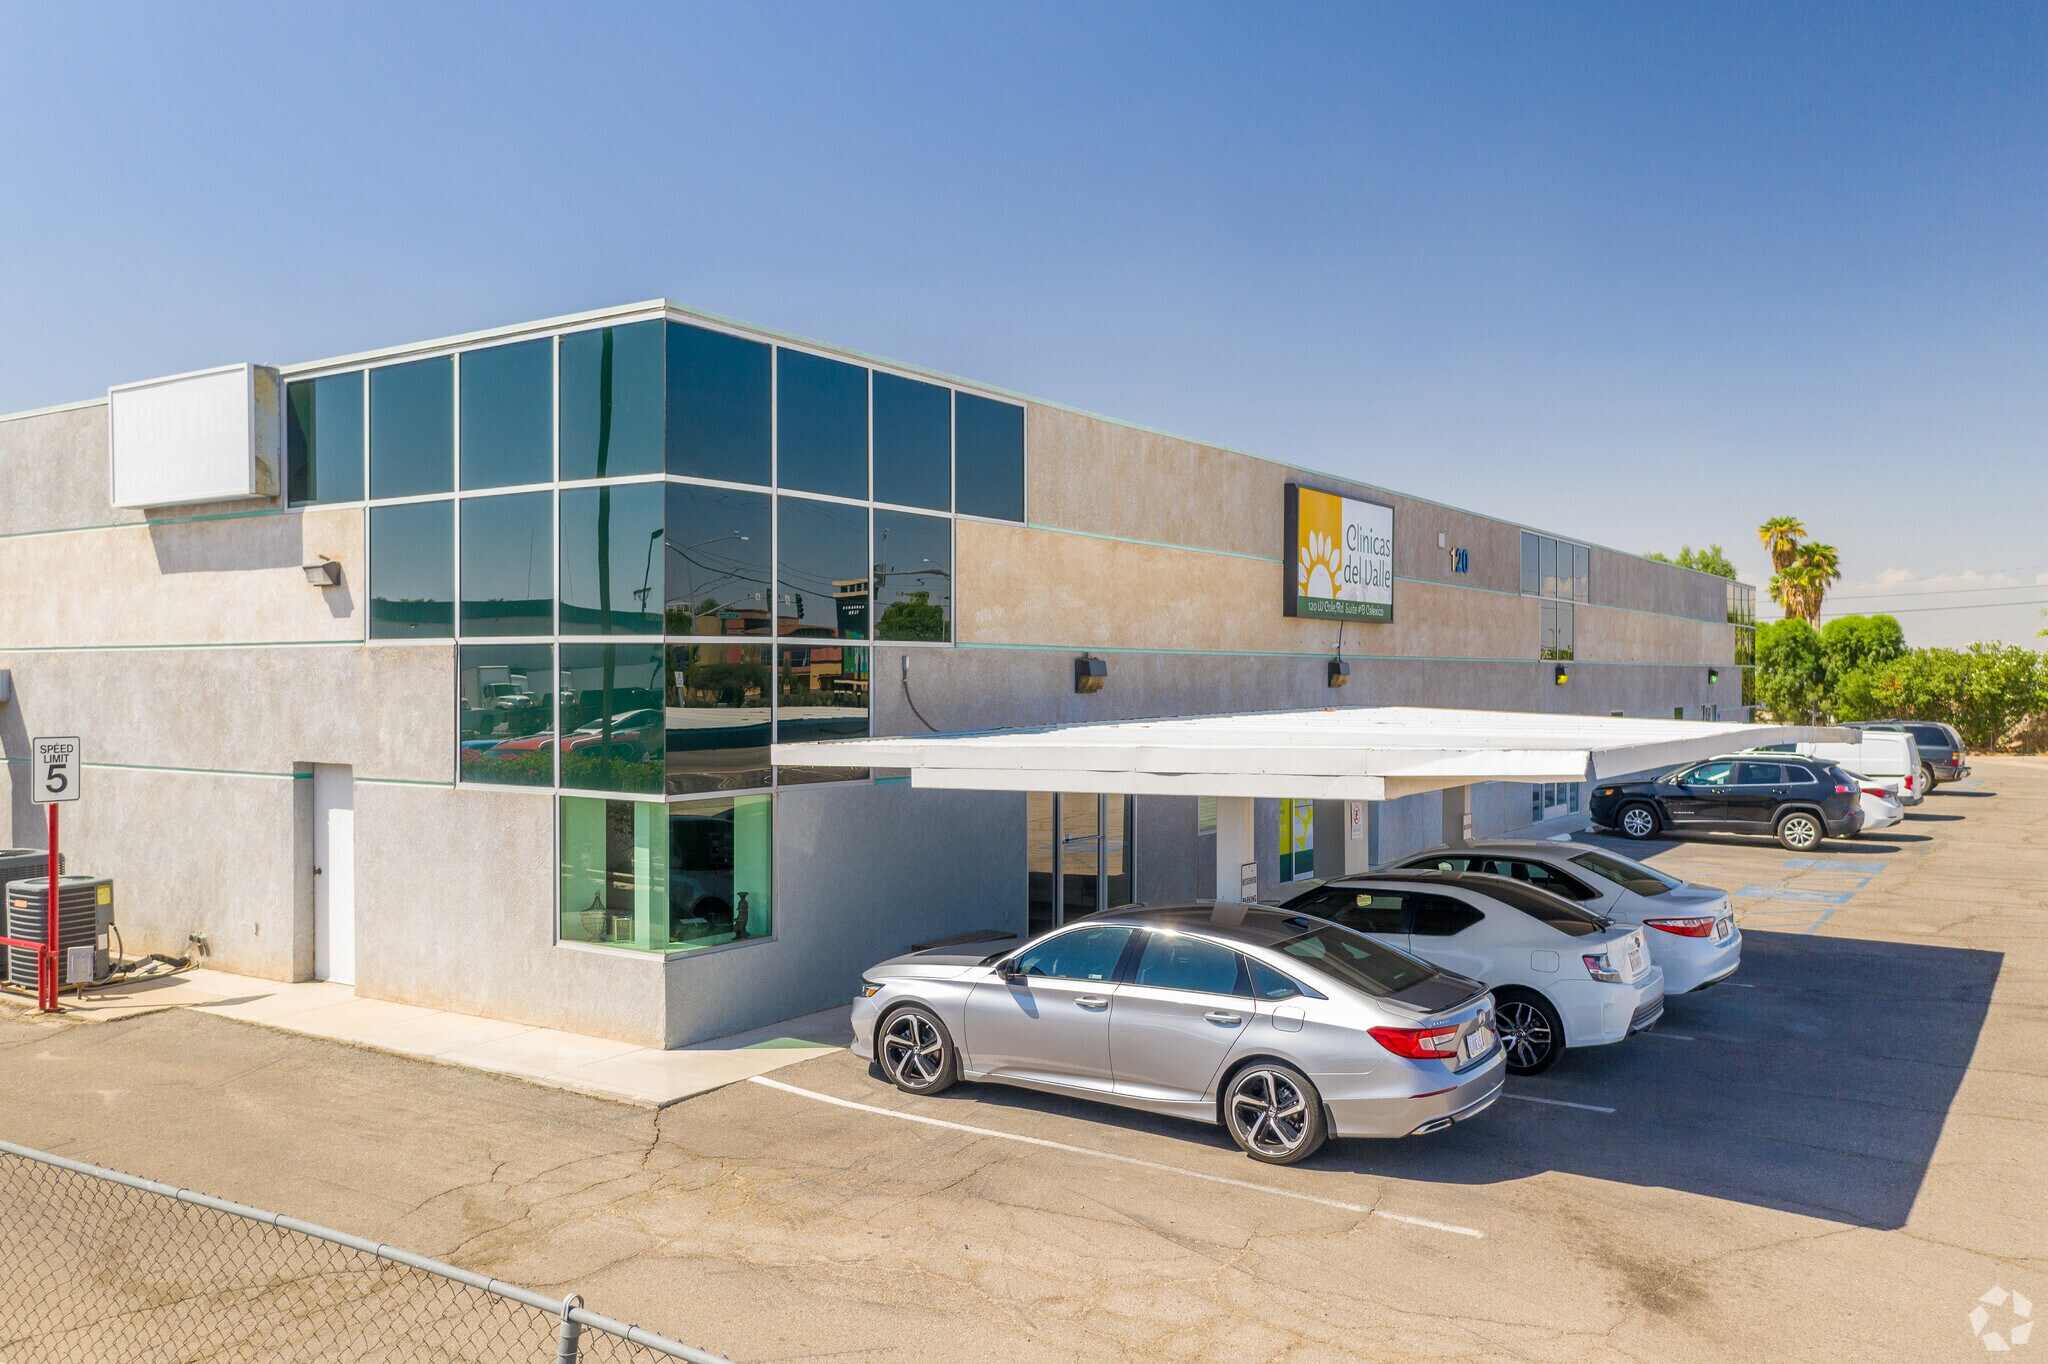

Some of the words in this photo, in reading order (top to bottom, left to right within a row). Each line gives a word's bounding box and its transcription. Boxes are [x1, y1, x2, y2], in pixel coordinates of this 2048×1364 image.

[1450, 547, 1469, 574] 120
[1343, 555, 1361, 585] del
[1364, 559, 1391, 589] Valle
[1308, 602, 1317, 611] 120
[1345, 602, 1357, 614] Suite
[1366, 604, 1384, 616] Calexico
[40, 744, 74, 754] SPEED
[43, 754, 70, 763] LIMIT
[46, 764, 68, 793] 5
